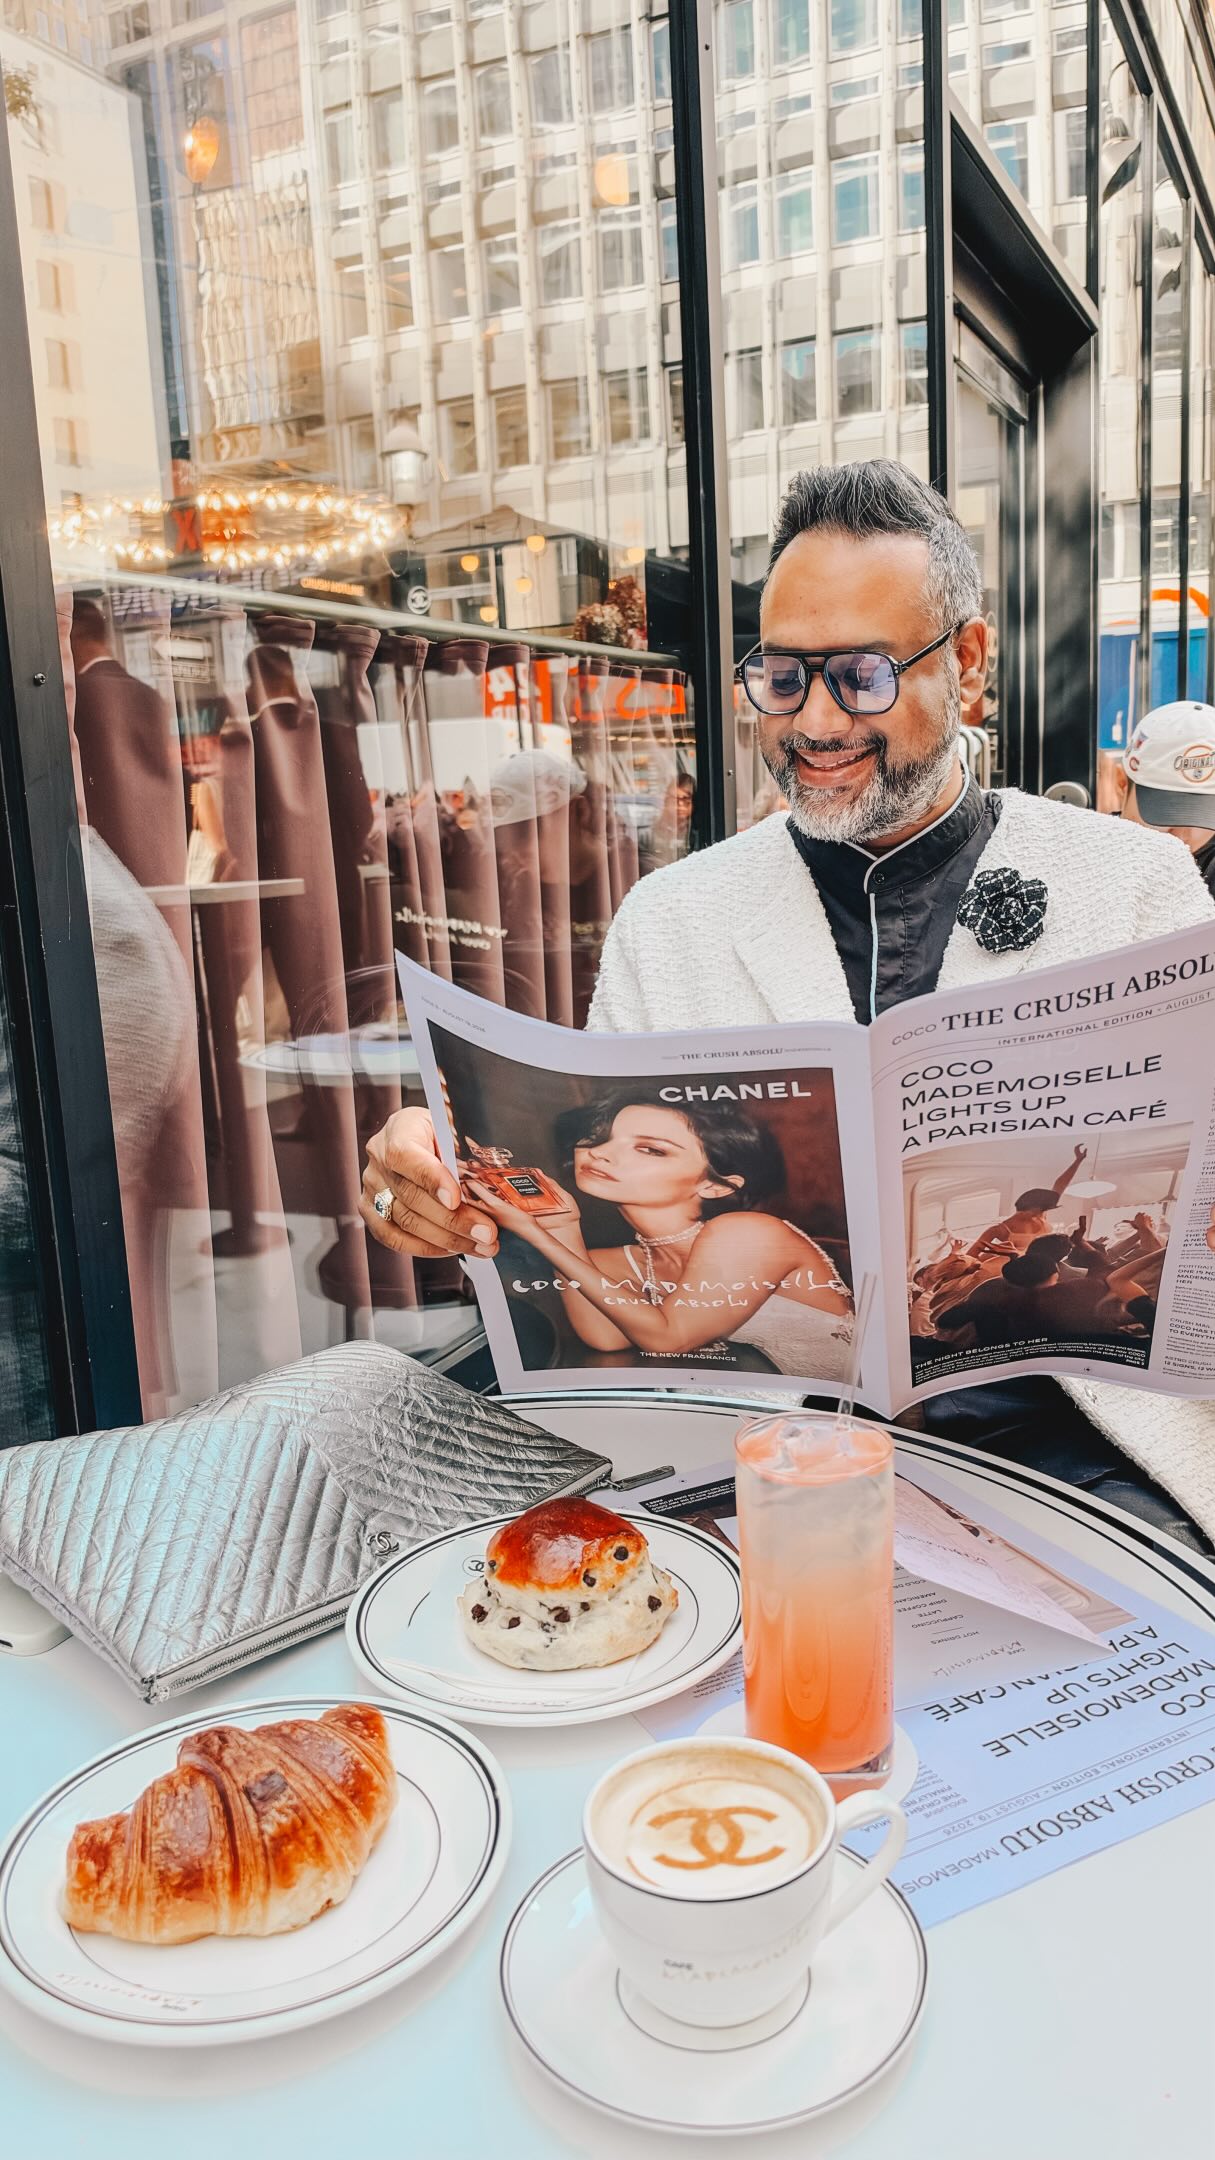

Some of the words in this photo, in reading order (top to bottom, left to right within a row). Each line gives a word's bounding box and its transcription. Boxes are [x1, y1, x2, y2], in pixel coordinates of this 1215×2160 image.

[892, 1023, 937, 1046] COCO
[942, 1008, 1003, 1031] THE
[1013, 981, 1115, 1022] CRUSH
[1123, 951, 1215, 998] ABSOL
[998, 1023, 1098, 1046] INTERNATIONAL
[1103, 1009, 1153, 1028] EDITION
[1165, 991, 1211, 1011] AUGUST
[704, 1050, 740, 1060] CRUSH
[742, 1047, 784, 1058] ABSOLU
[901, 1059, 993, 1088] COCO
[902, 1054, 1163, 1111] MADEMOISELLE
[658, 1081, 812, 1103] CHANEL
[903, 1100, 1012, 1131] LIGHTS
[1022, 1095, 1067, 1112] UP
[902, 1136, 921, 1153] A
[928, 1115, 1075, 1143] PARISIAN
[1083, 1099, 1168, 1126] CAFÉ
[510, 1278, 582, 1293] COCO
[603, 1297, 664, 1308] CRUSH
[674, 1294, 749, 1308] ABSOLU
[1169, 1322, 1191, 1331] COCO
[659, 1352, 681, 1360] NEW
[682, 1353, 737, 1363] FRAGRANCE
[914, 1360, 933, 1370] THE
[935, 1350, 964, 1363] NIGHT
[965, 1342, 1012, 1355] BELONGS
[1013, 1340, 1026, 1348] TO
[1027, 1337, 1049, 1345] HER
[897, 1603, 928, 1613] COFFEE
[918, 1609, 942, 1618] LATTE
[929, 1598, 948, 1607] DRIP
[911, 1614, 964, 1629] CAPPUCCINO
[1133, 1625, 1159, 1639] A
[930, 1634, 962, 1645] DRINKS
[963, 1630, 980, 1638] HOT
[1086, 1642, 1190, 1687] LIGHTS
[1046, 1682, 1090, 1704] UP
[981, 1658, 1215, 1757] MADEMOISELLE
[1104, 1728, 1191, 1769] INTERNATIONAL
[1050, 1767, 1100, 1791] EDITION
[1114, 1754, 1215, 1805] CRUSH
[942, 1791, 961, 1802] THE
[993, 1791, 1042, 1815] AUGUST
[1000, 1794, 1116, 1857] ABSOLU
